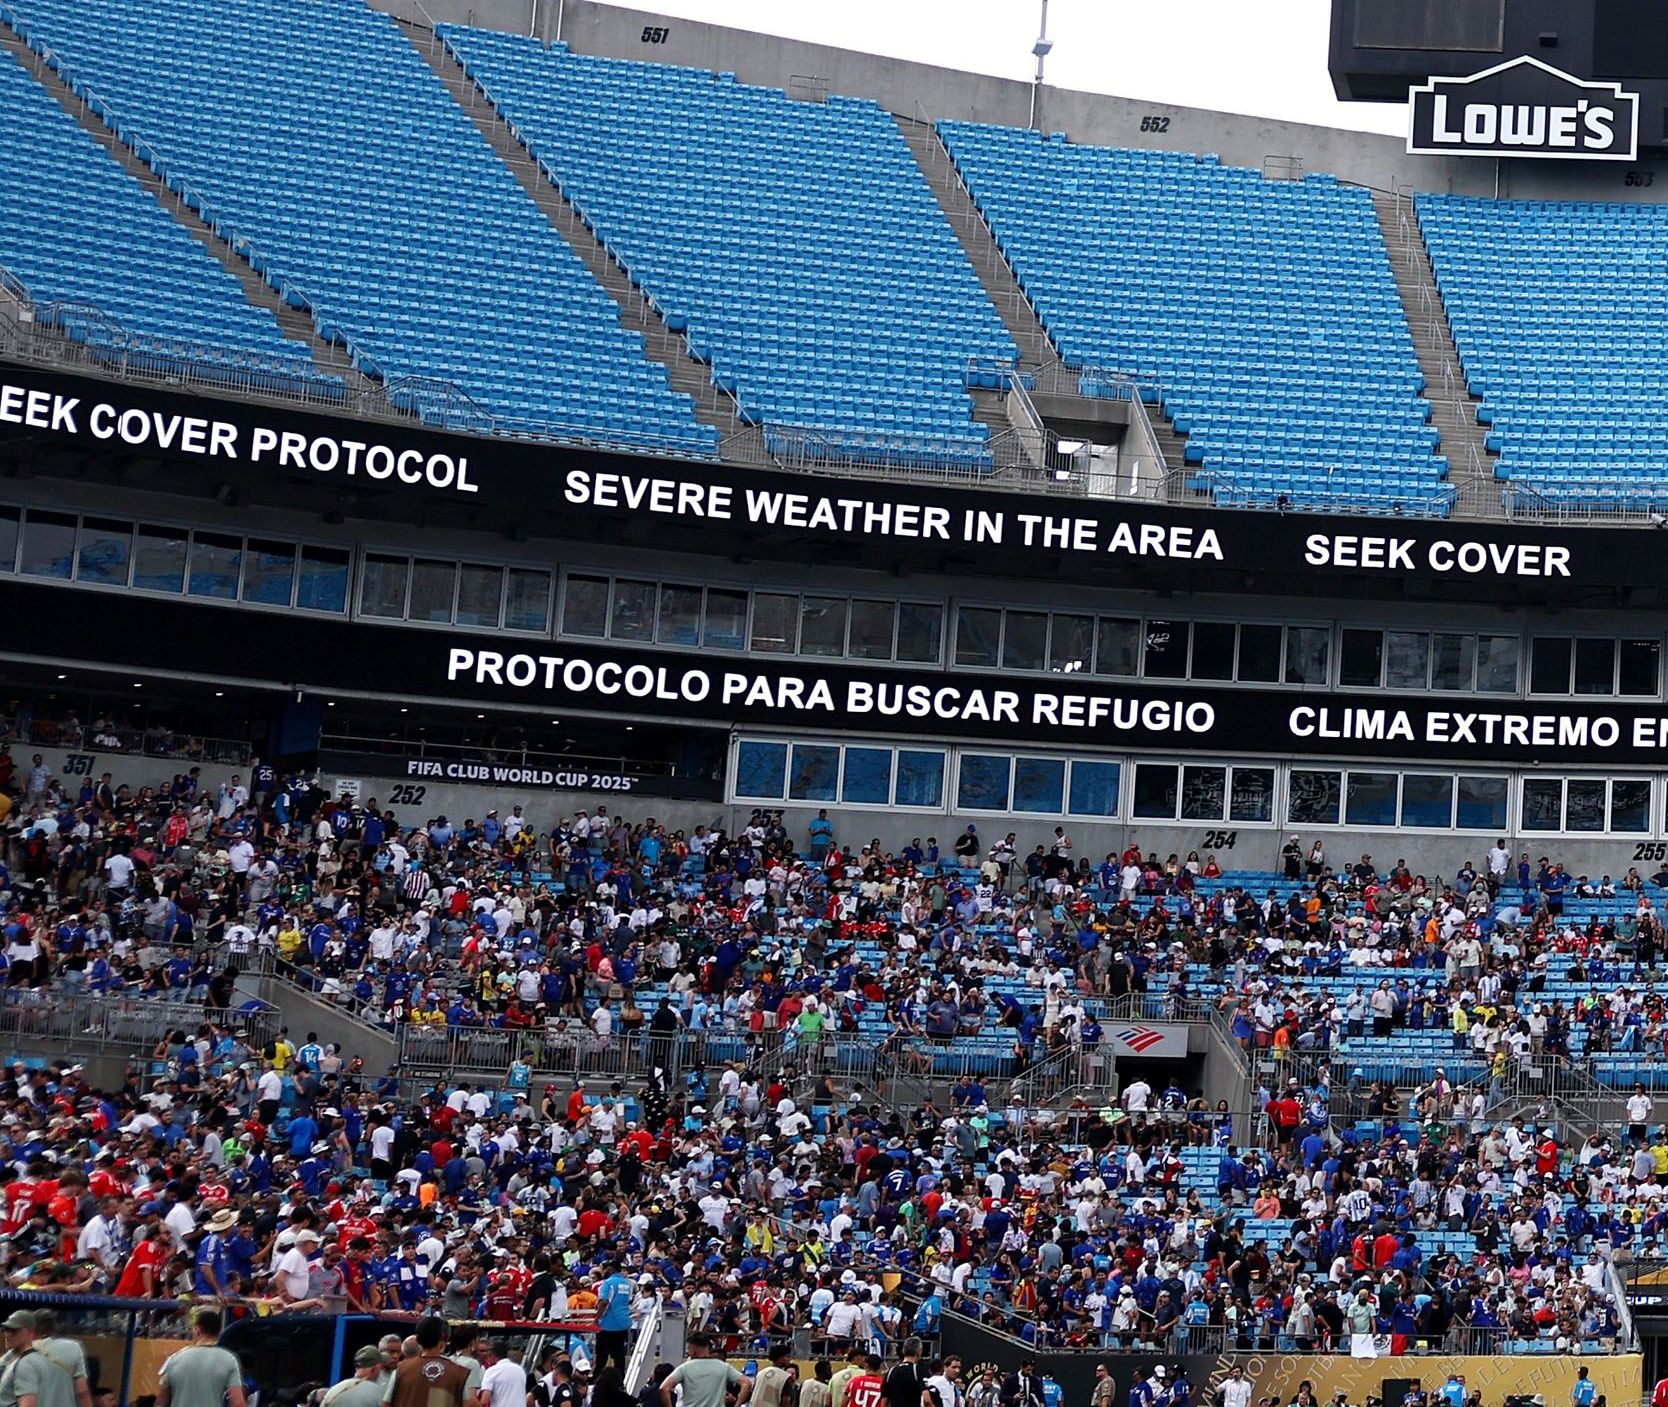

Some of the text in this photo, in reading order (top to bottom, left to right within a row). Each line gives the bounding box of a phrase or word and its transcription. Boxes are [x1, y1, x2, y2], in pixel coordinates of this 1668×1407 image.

[641, 26, 670, 45] 551
[1140, 115, 1170, 133] 552
[1432, 96, 1615, 149] LOWE'S
[1624, 170, 1654, 188] 553
[0, 385, 479, 493] EEK COVER PROTOCOL
[564, 470, 1224, 560] SEVERE WEATHER IN THE AREA
[1304, 534, 1571, 577] SEEK COVER
[447, 648, 1215, 733] PROTOCOLO PARA BUSCAR REFUGIO
[1289, 706, 1415, 741] CLIMA
[1426, 711, 1620, 747] EXTREMO
[62, 754, 96, 776] 351
[259, 769, 273, 780] 25
[407, 760, 588, 787] FIFA CLUB WORLD CUP
[388, 783, 427, 805] 252
[1202, 831, 1237, 849] 254
[1632, 842, 1667, 862] 255
[893, 1179, 902, 1191] 7
[12, 1199, 32, 1222] 17
[1354, 1198, 1366, 1210] 10
[855, 1388, 883, 1407] 47
